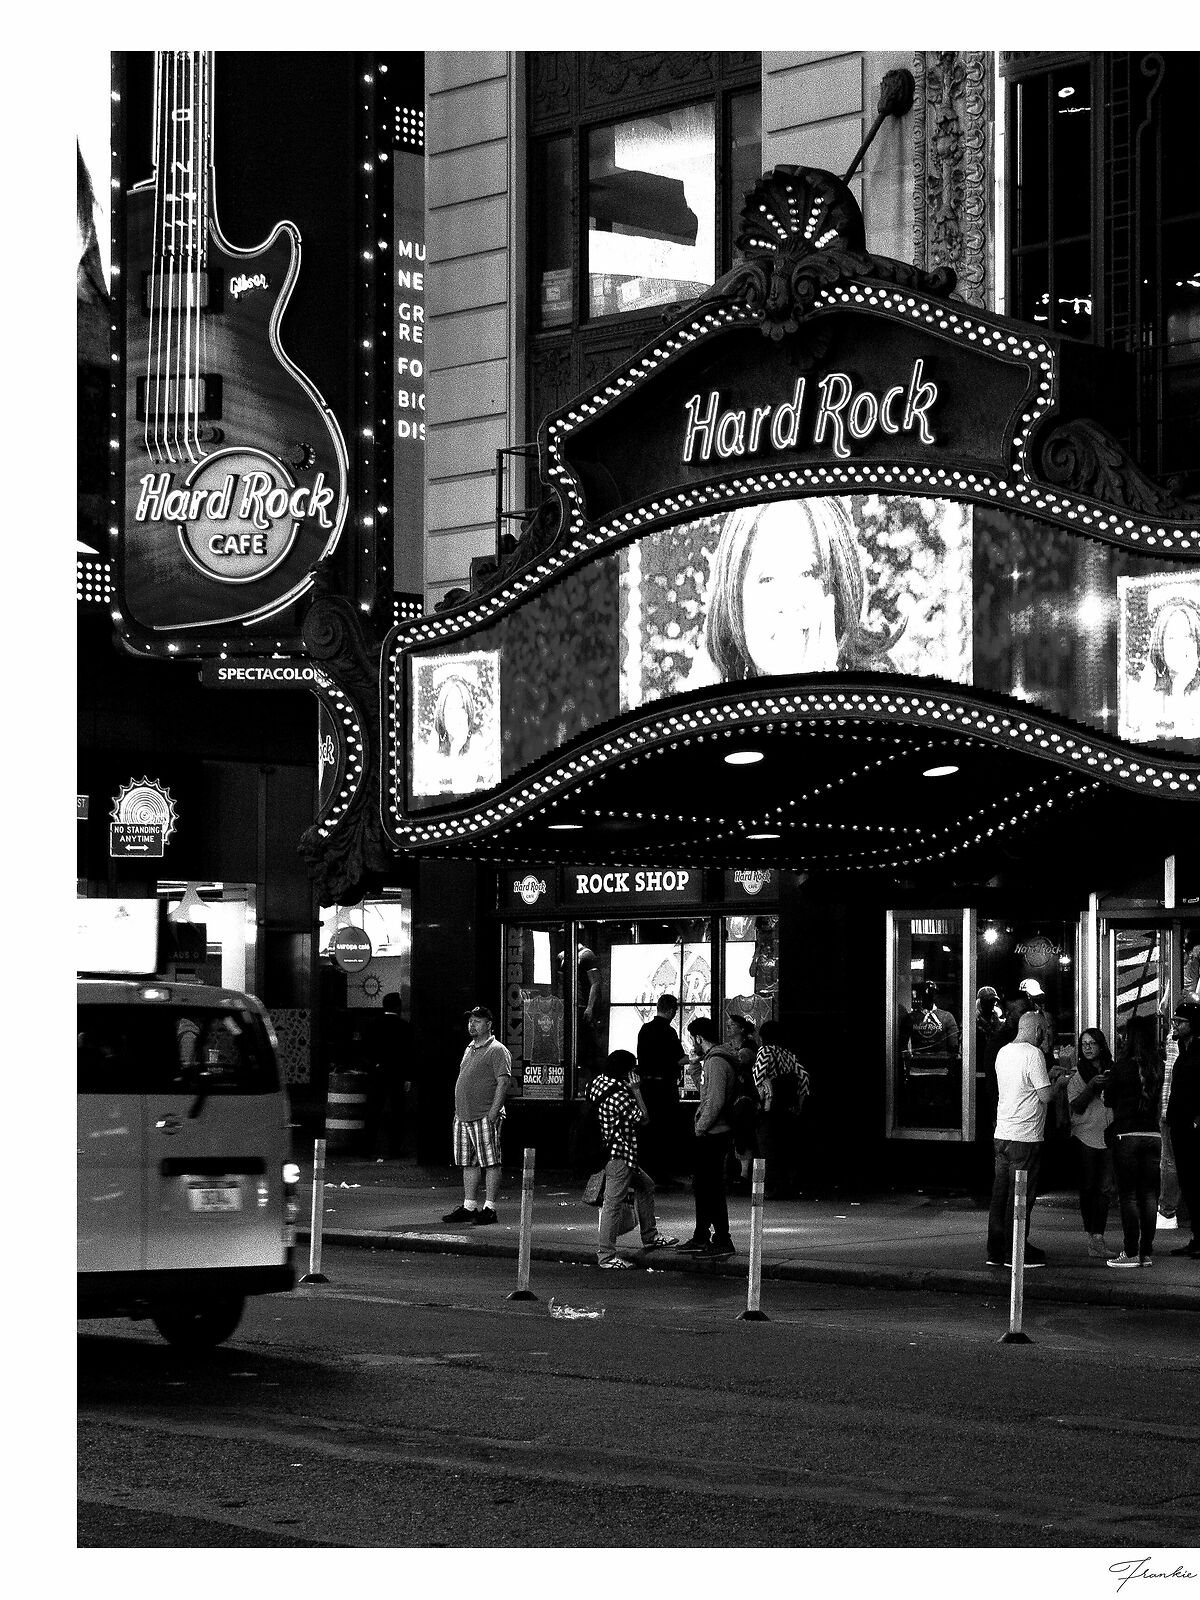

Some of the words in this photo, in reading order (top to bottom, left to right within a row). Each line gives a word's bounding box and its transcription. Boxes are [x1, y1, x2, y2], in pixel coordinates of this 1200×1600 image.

[684, 377, 806, 462] Hard
[815, 359, 938, 458] Rock
[136, 472, 234, 522] Hard
[239, 471, 334, 529] Rock
[208, 534, 266, 555] CAFE
[218, 667, 318, 680] SPECTACOLO
[114, 825, 125, 834] NO
[127, 825, 160, 834] STANDING
[119, 835, 155, 843] ANYTIME
[513, 880, 531, 893] Hard
[530, 880, 547, 893] Rock
[576, 873, 630, 894] ROCK
[635, 870, 690, 892] SHOP
[525, 1066, 542, 1075] GIVE
[523, 1075, 541, 1084] BACK
